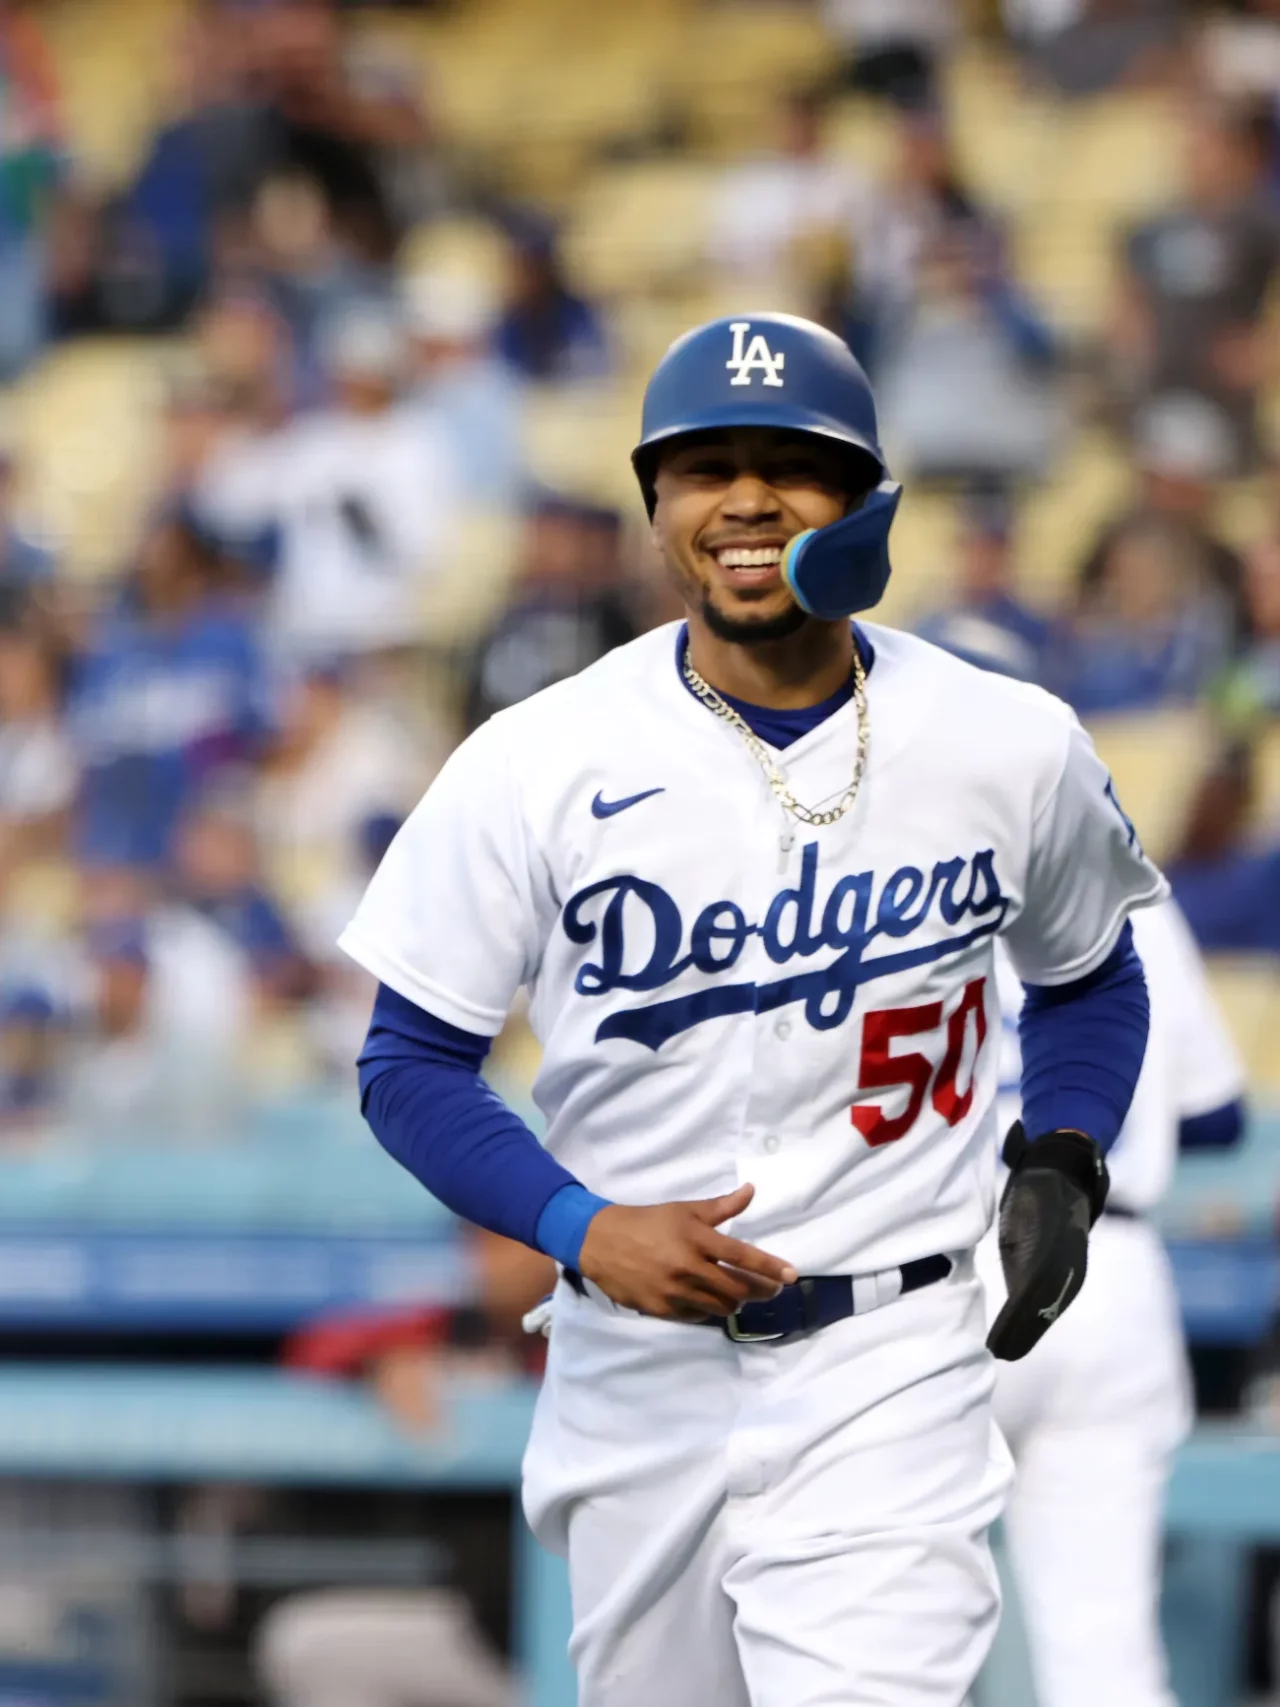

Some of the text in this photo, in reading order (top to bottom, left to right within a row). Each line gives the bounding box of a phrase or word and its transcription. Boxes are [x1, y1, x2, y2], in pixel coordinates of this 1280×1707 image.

[725, 322, 785, 388] LA
[562, 841, 1010, 1031] Dodgers
[850, 976, 987, 1148] 50
